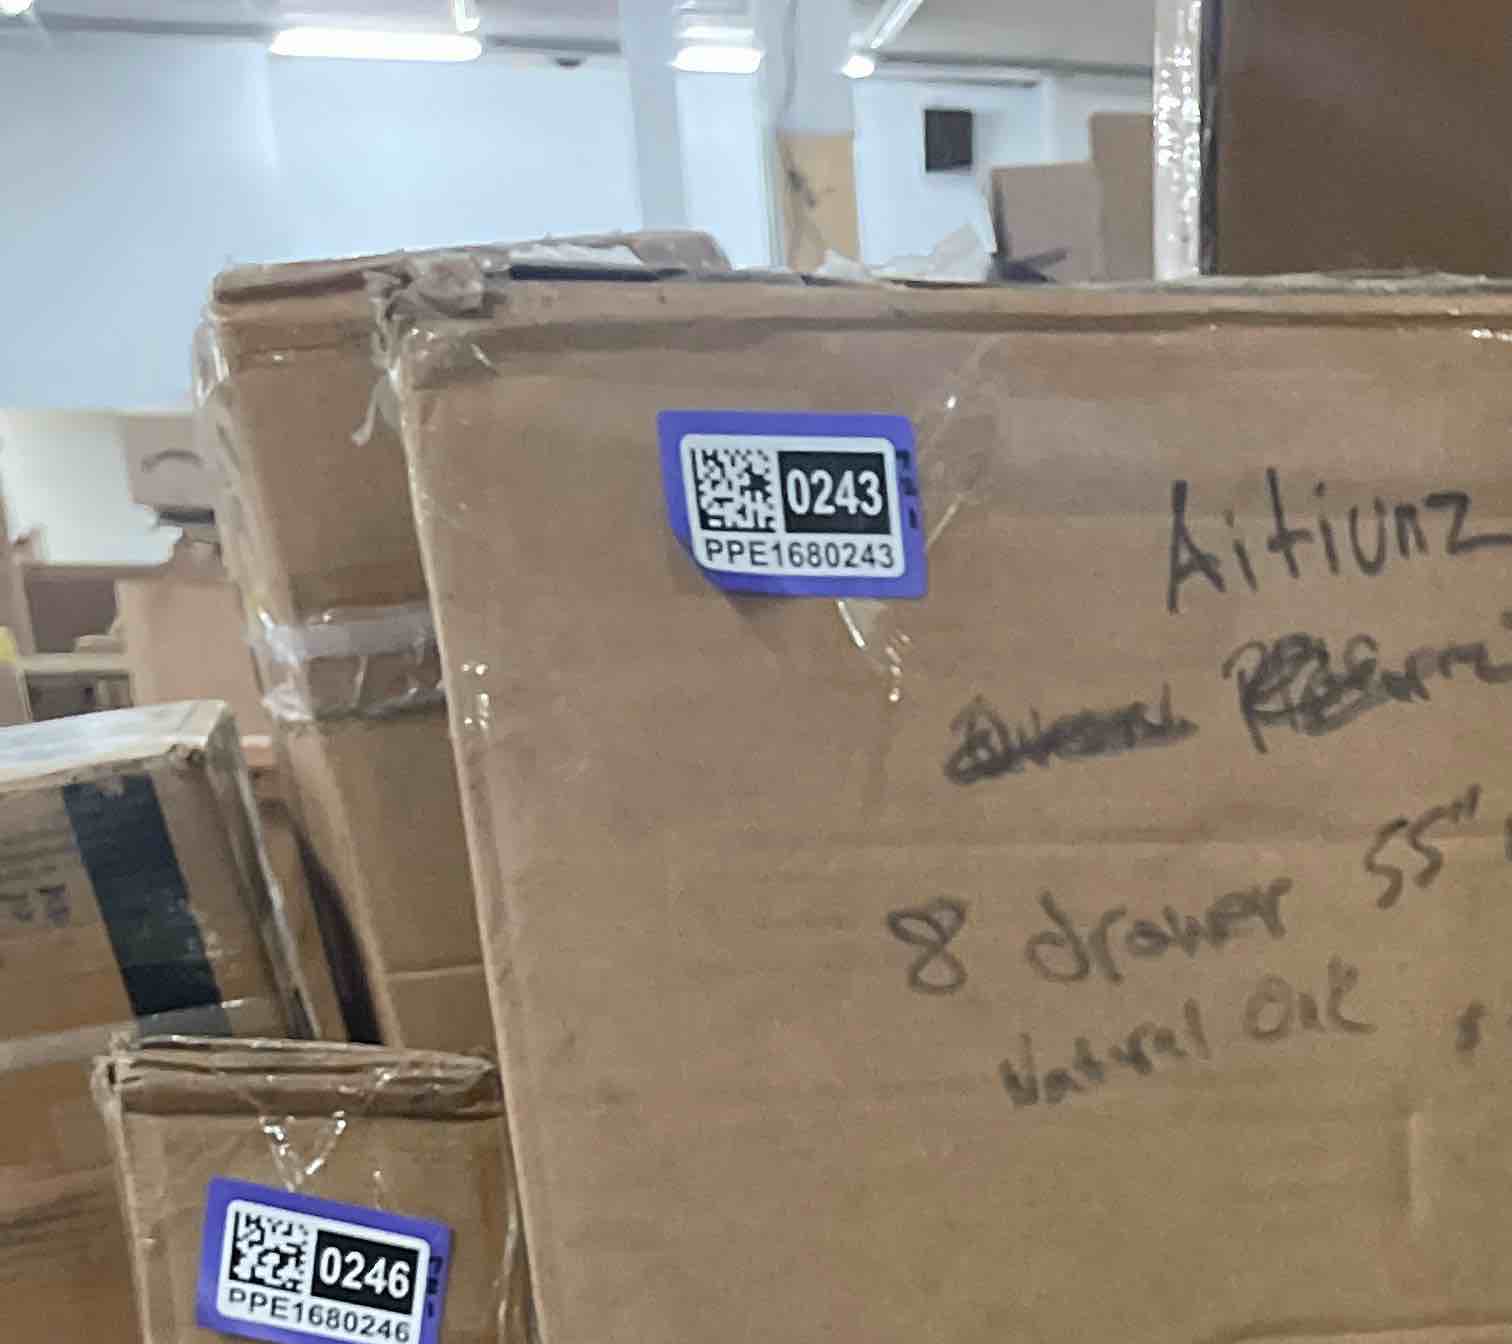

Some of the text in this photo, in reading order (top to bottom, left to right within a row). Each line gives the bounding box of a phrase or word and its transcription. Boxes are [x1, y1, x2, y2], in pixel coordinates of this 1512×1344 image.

[785, 468, 884, 517] 0243
[704, 538, 896, 570] PPE1680243
[887, 896, 969, 993] 8
[319, 1246, 411, 1299] 0246
[228, 1287, 410, 1344] PPE1680246
